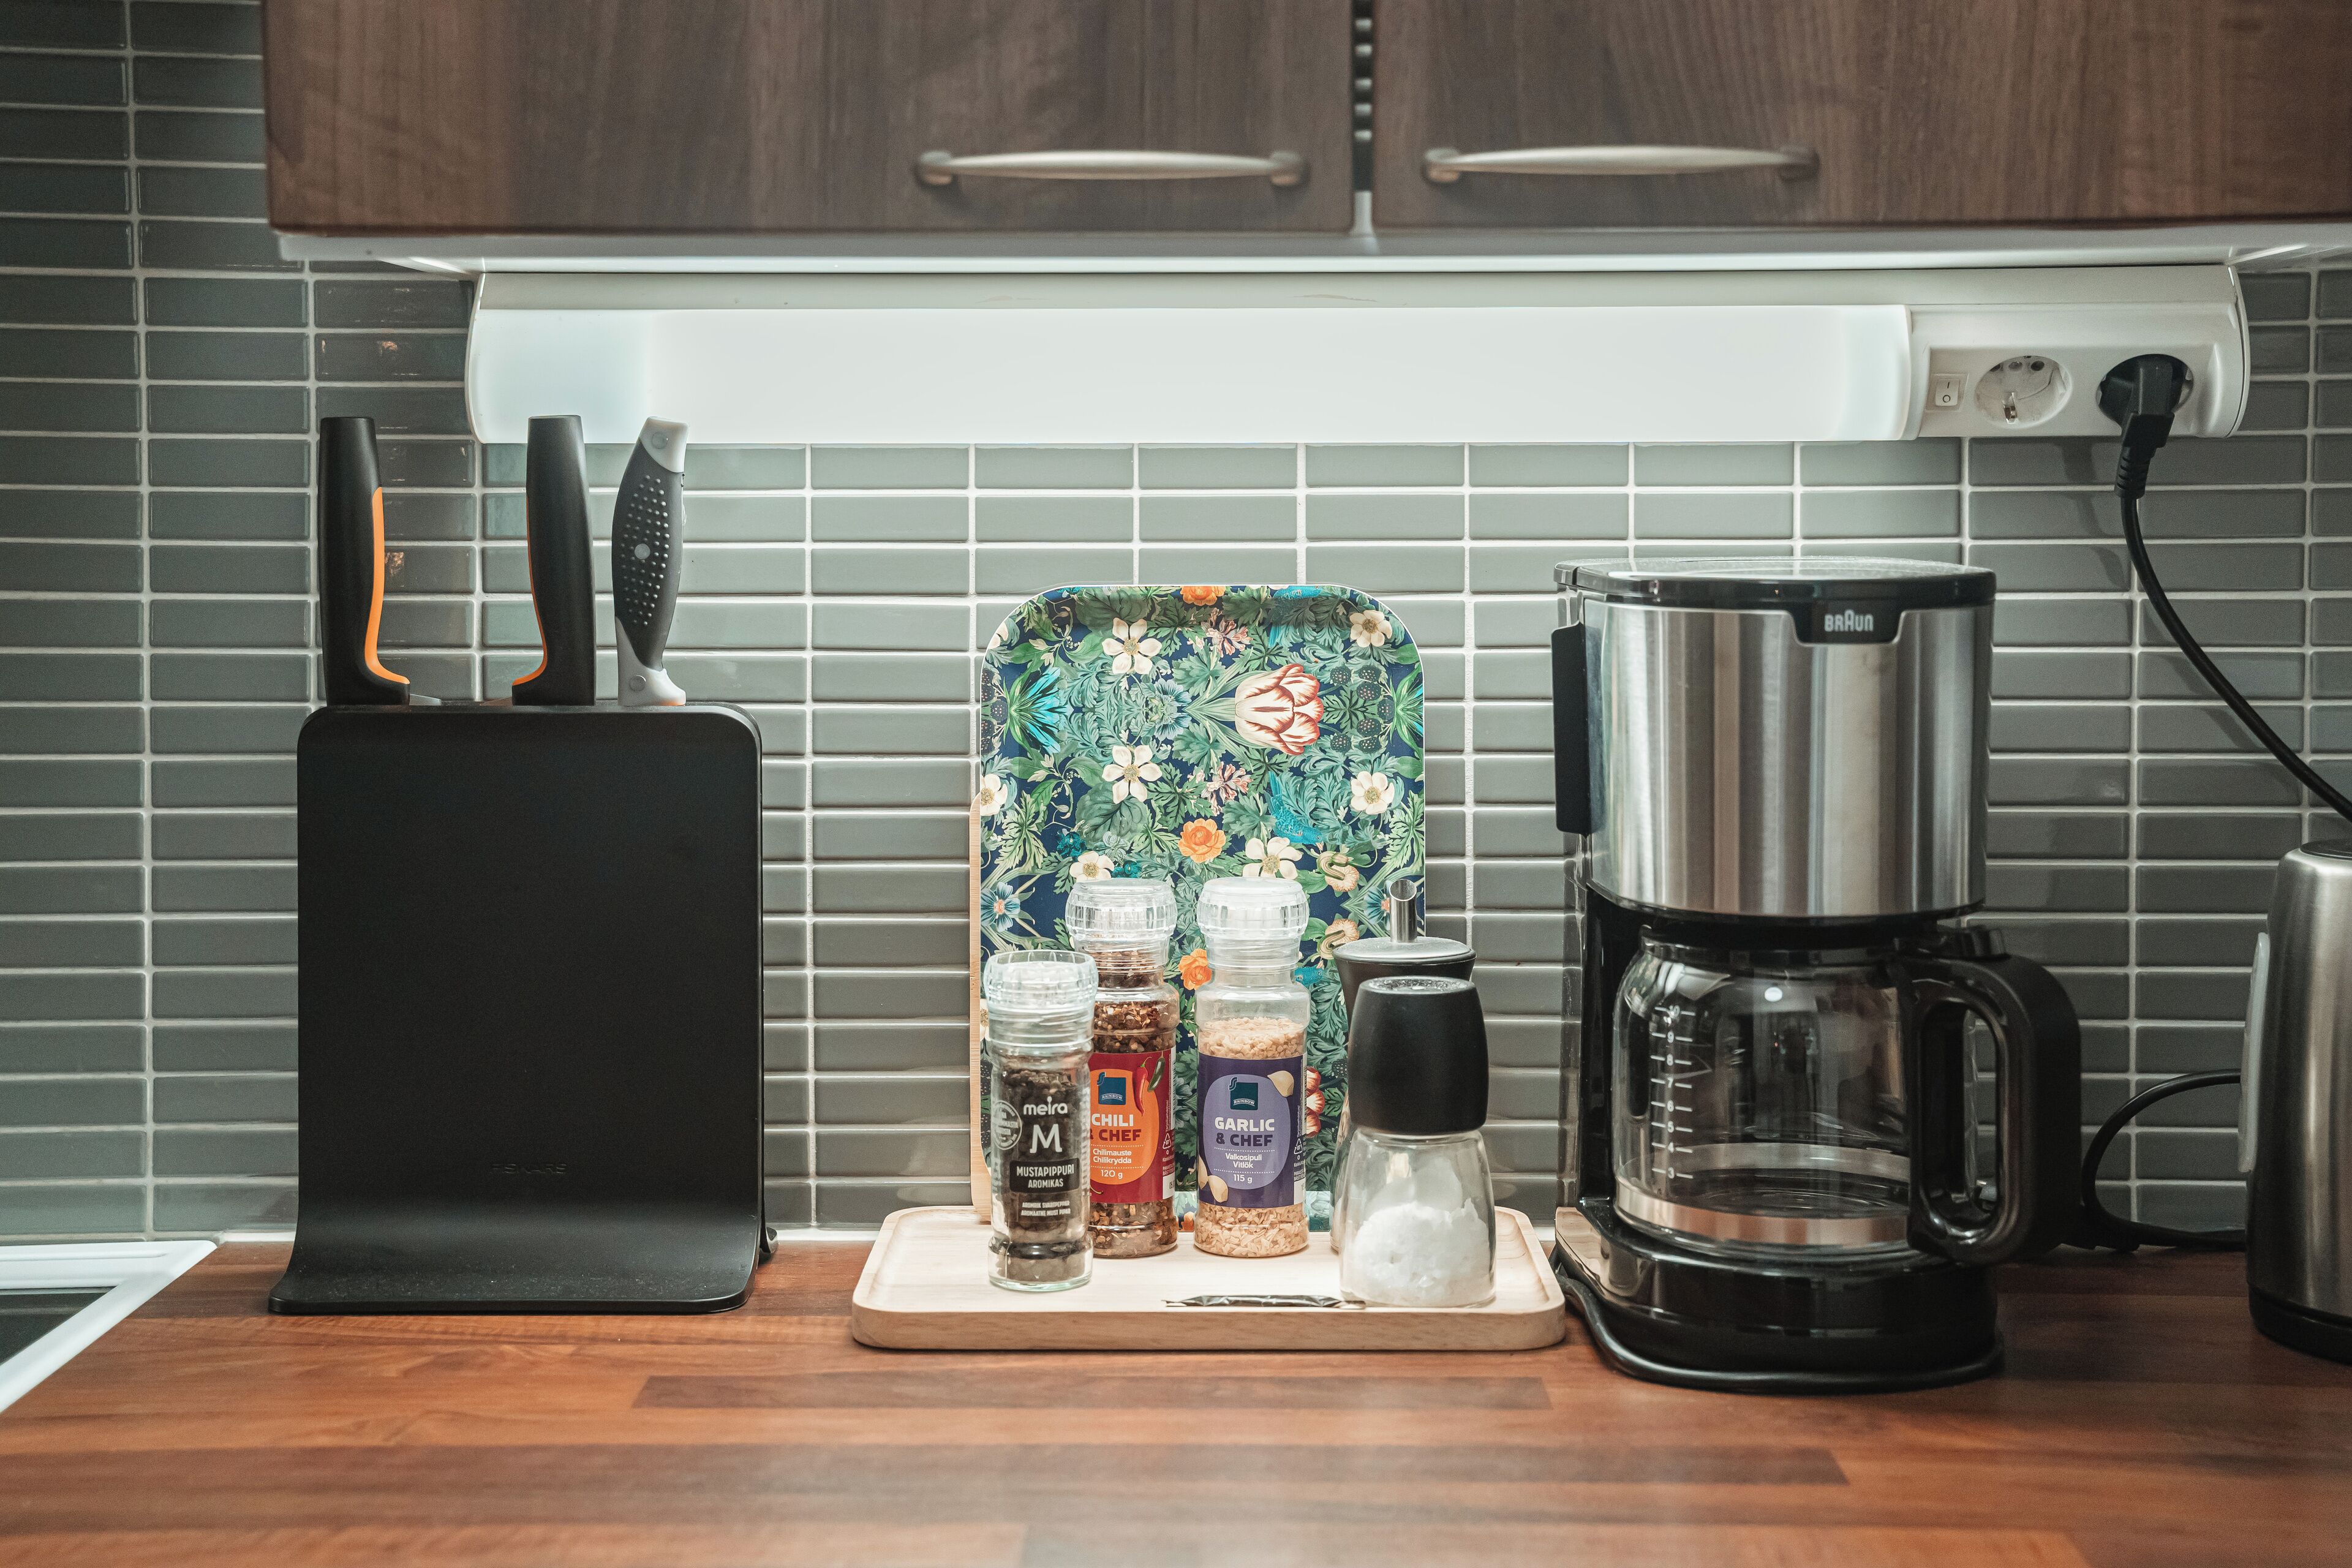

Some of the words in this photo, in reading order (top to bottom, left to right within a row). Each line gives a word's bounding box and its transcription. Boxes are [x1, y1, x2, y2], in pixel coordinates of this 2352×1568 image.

[1825, 609, 1874, 631] BRAUN
[1667, 1054, 1673, 1066] 8
[1667, 1077, 1673, 1088] 7
[1023, 1096, 1068, 1115] meira
[1091, 1114, 1134, 1126] CHILI
[1215, 1117, 1275, 1132] GARLIC
[1030, 1123, 1063, 1153] M
[1099, 1129, 1142, 1141] CHEF
[1216, 1133, 1225, 1144] &
[1230, 1134, 1273, 1147] CHEF
[1667, 1142, 1674, 1153] 4
[1093, 1156, 1132, 1164] Chilikrydda
[1225, 1152, 1262, 1162] Valkosipuli
[1017, 1164, 1074, 1177] MUSTAPIPPURI
[1667, 1167, 1674, 1178] 3
[1028, 1179, 1063, 1188] AROMIKAS
